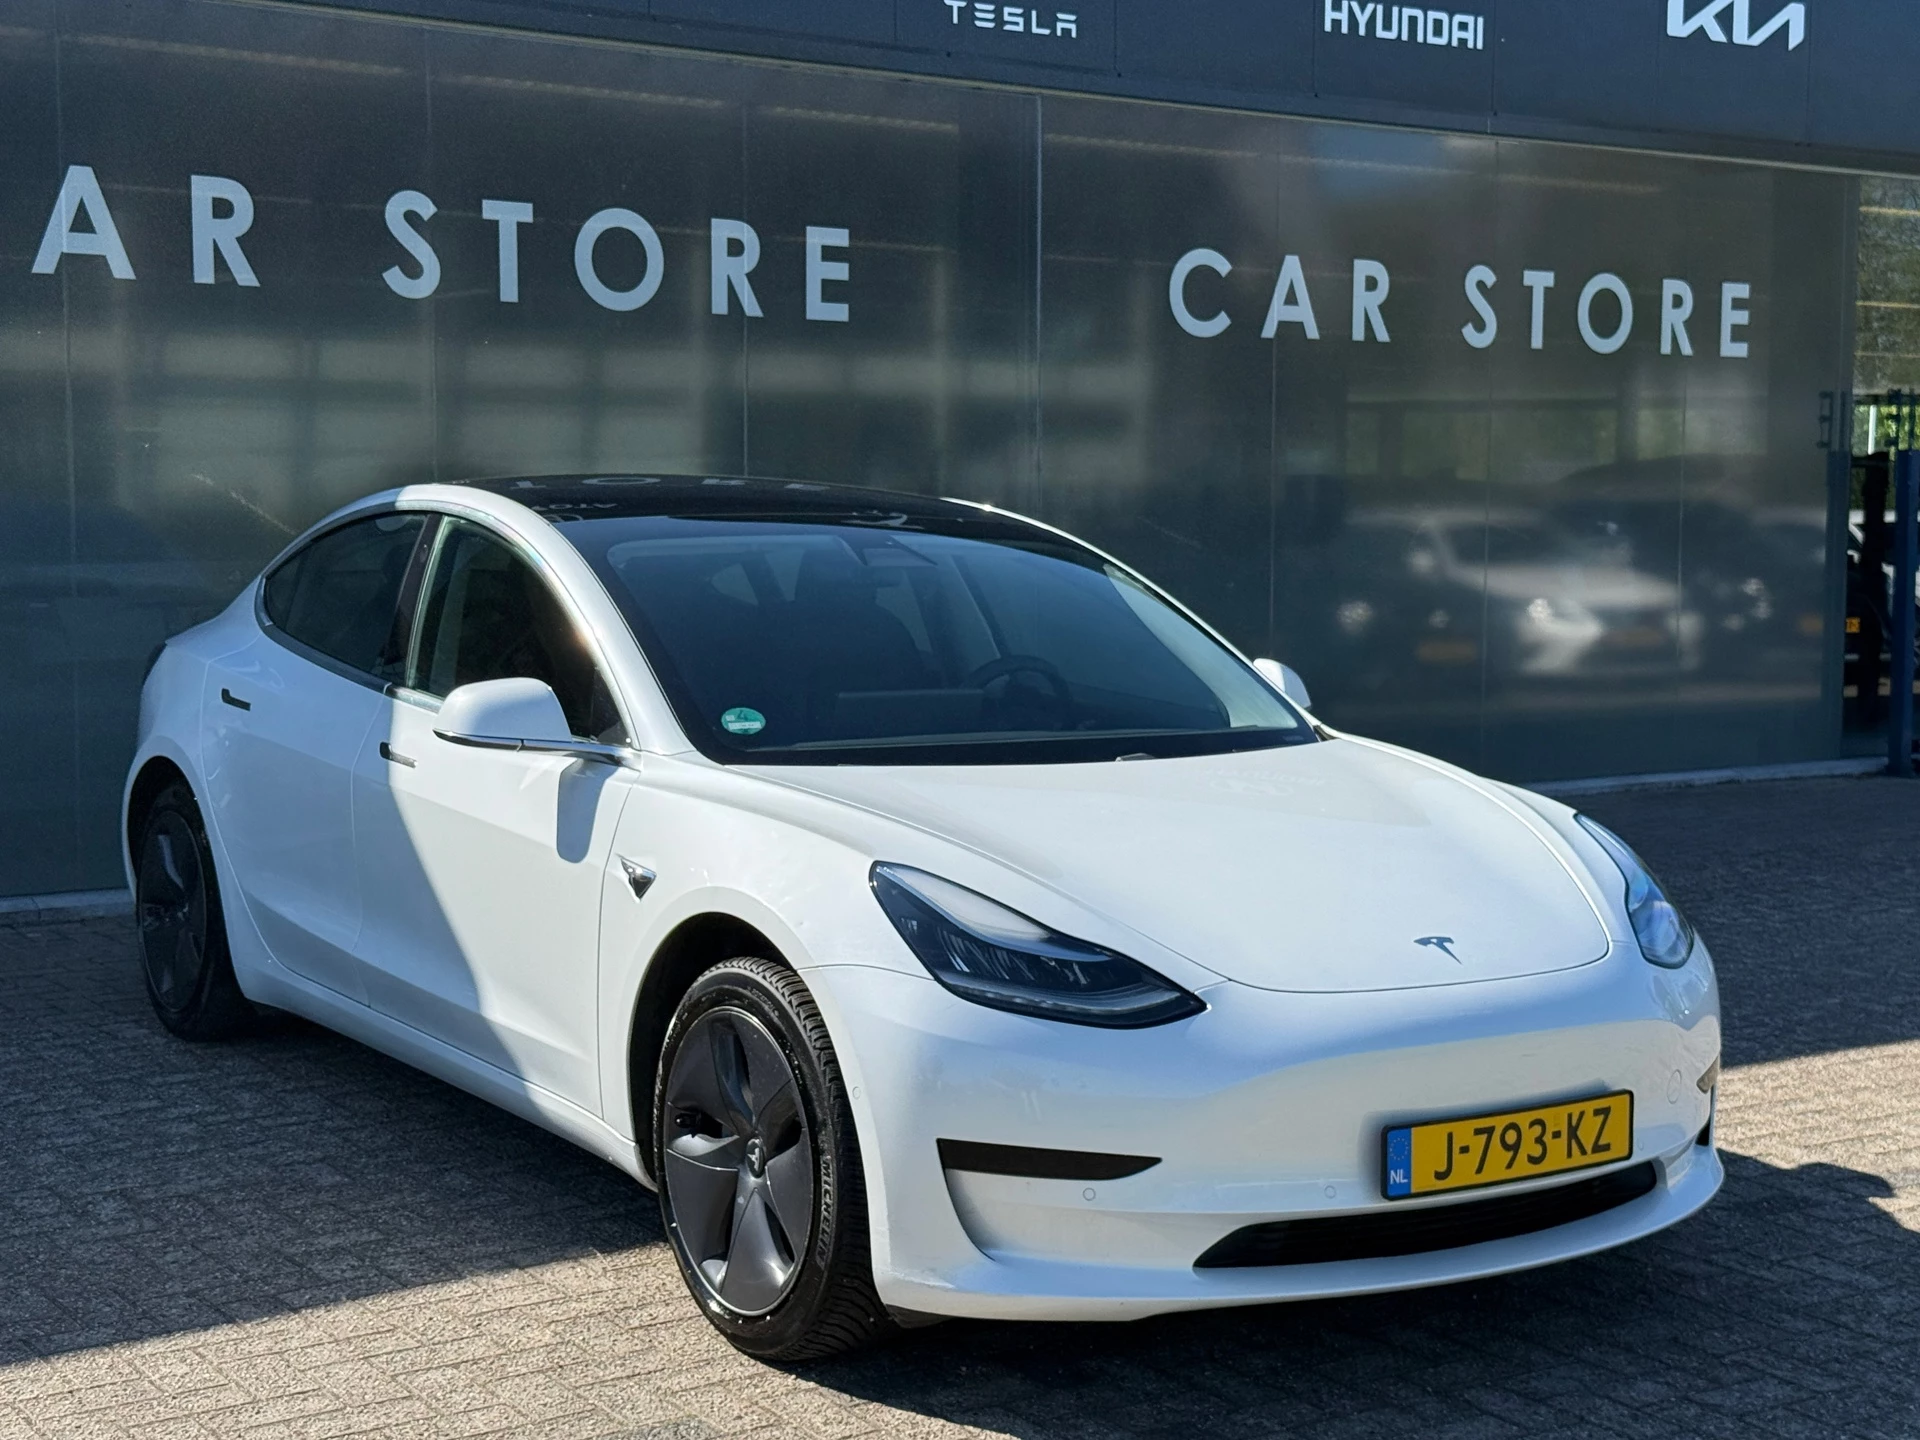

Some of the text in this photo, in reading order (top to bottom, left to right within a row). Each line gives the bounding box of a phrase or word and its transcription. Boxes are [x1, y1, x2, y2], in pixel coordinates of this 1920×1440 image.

[943, 0, 1077, 38] TESLA
[1324, 0, 1484, 50] HYUNDAI
[1666, 0, 1806, 51] KIA
[382, 190, 850, 322] STORE
[1169, 248, 1750, 358] CAR STORE
[1433, 1106, 1612, 1181] J-793-KZ
[1390, 1169, 1408, 1184] NL
[816, 1158, 833, 1270] MICHELIN
